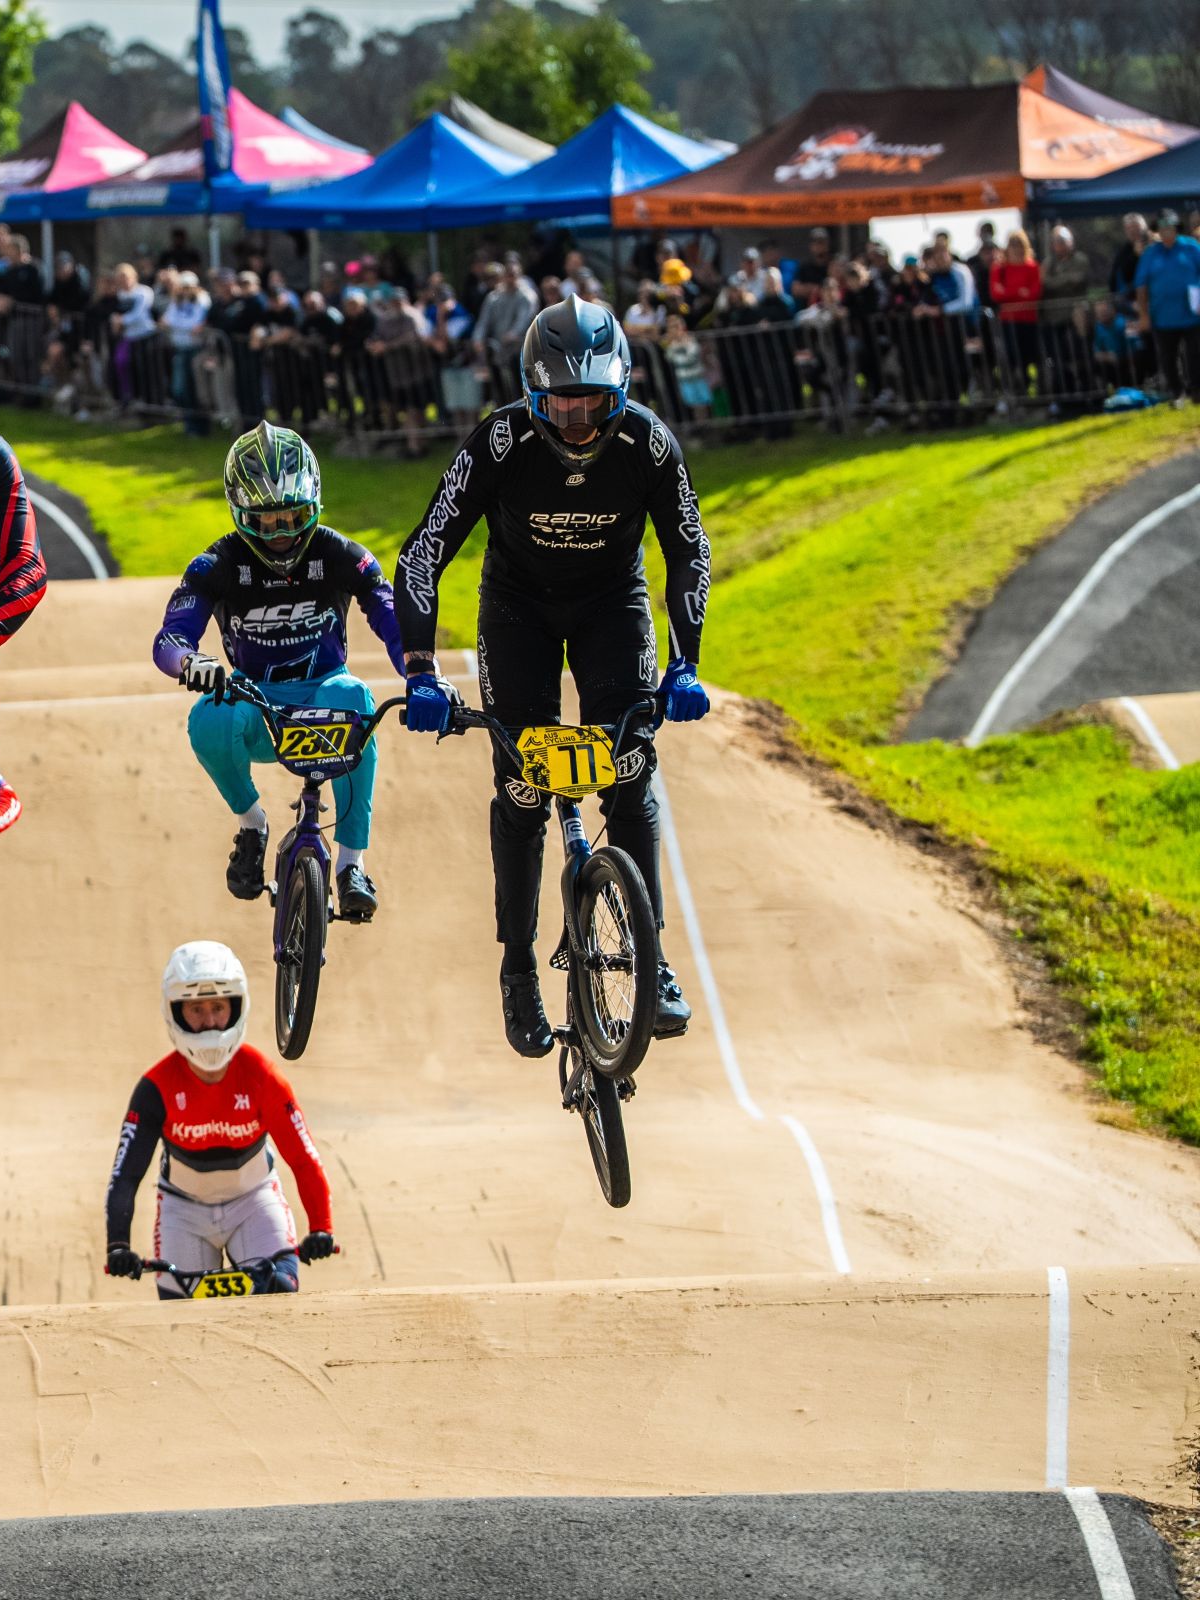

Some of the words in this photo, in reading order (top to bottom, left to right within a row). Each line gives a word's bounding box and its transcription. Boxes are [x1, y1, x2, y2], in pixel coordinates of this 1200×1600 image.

[243, 600, 317, 622] ICE
[290, 708, 331, 719] ICE
[284, 726, 347, 757] 230
[543, 730, 559, 740] AUS
[544, 735, 576, 745] CYCLING
[557, 743, 597, 785] 77
[171, 1119, 261, 1140] KrankHaus
[204, 1275, 246, 1298] 333
